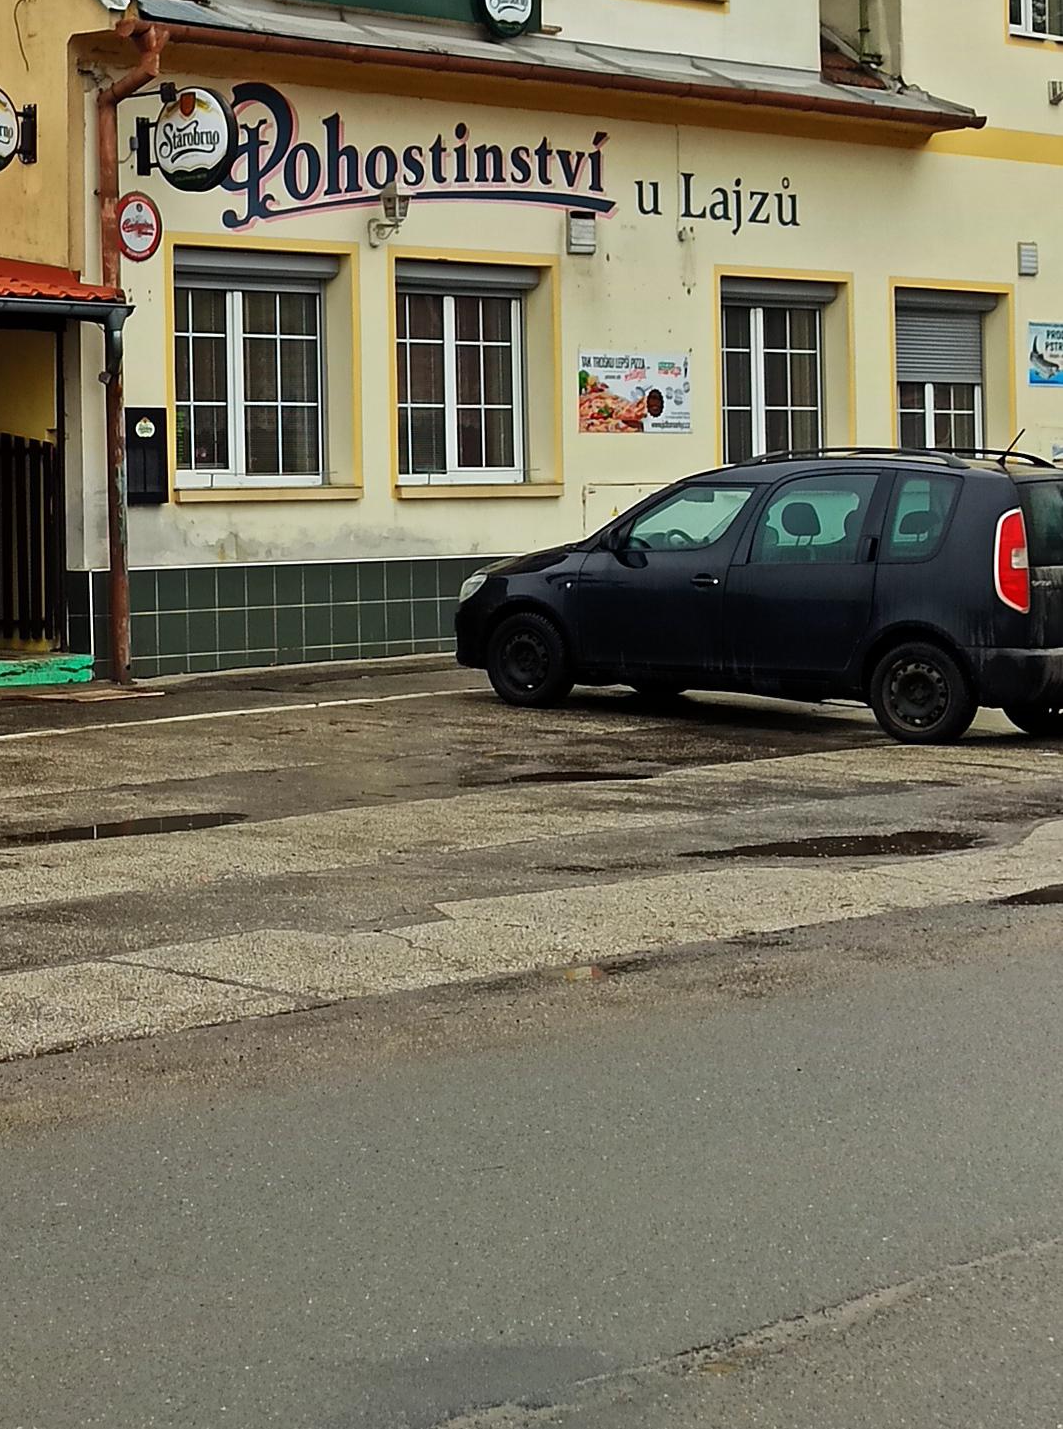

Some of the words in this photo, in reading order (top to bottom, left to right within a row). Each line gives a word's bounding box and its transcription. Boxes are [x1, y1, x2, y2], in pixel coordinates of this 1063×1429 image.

[159, 119, 220, 164] Starobrno
[222, 82, 609, 230] Pohostinství
[634, 160, 662, 216] u
[680, 172, 801, 235] Lajzů
